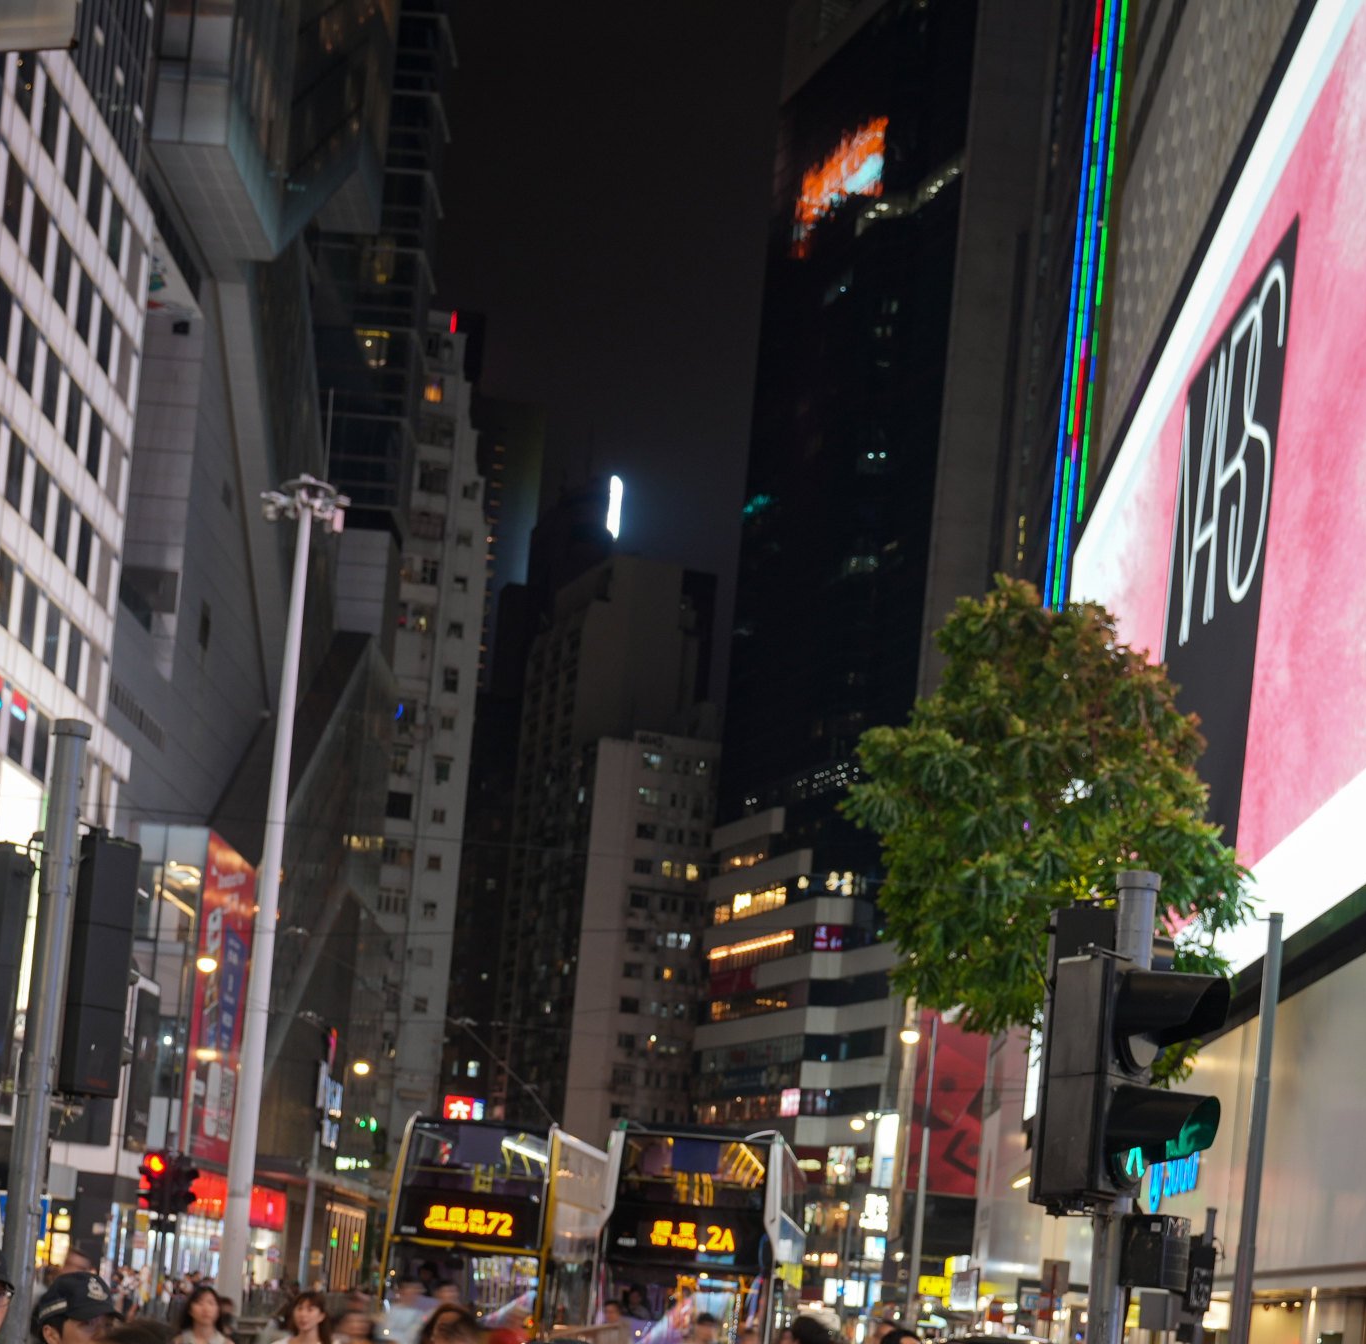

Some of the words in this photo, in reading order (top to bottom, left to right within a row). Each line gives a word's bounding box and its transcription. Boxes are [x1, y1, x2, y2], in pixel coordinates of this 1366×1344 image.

[1178, 258, 1287, 646] NARS
[486, 1211, 513, 1237] 72
[707, 1225, 734, 1252] 2A
